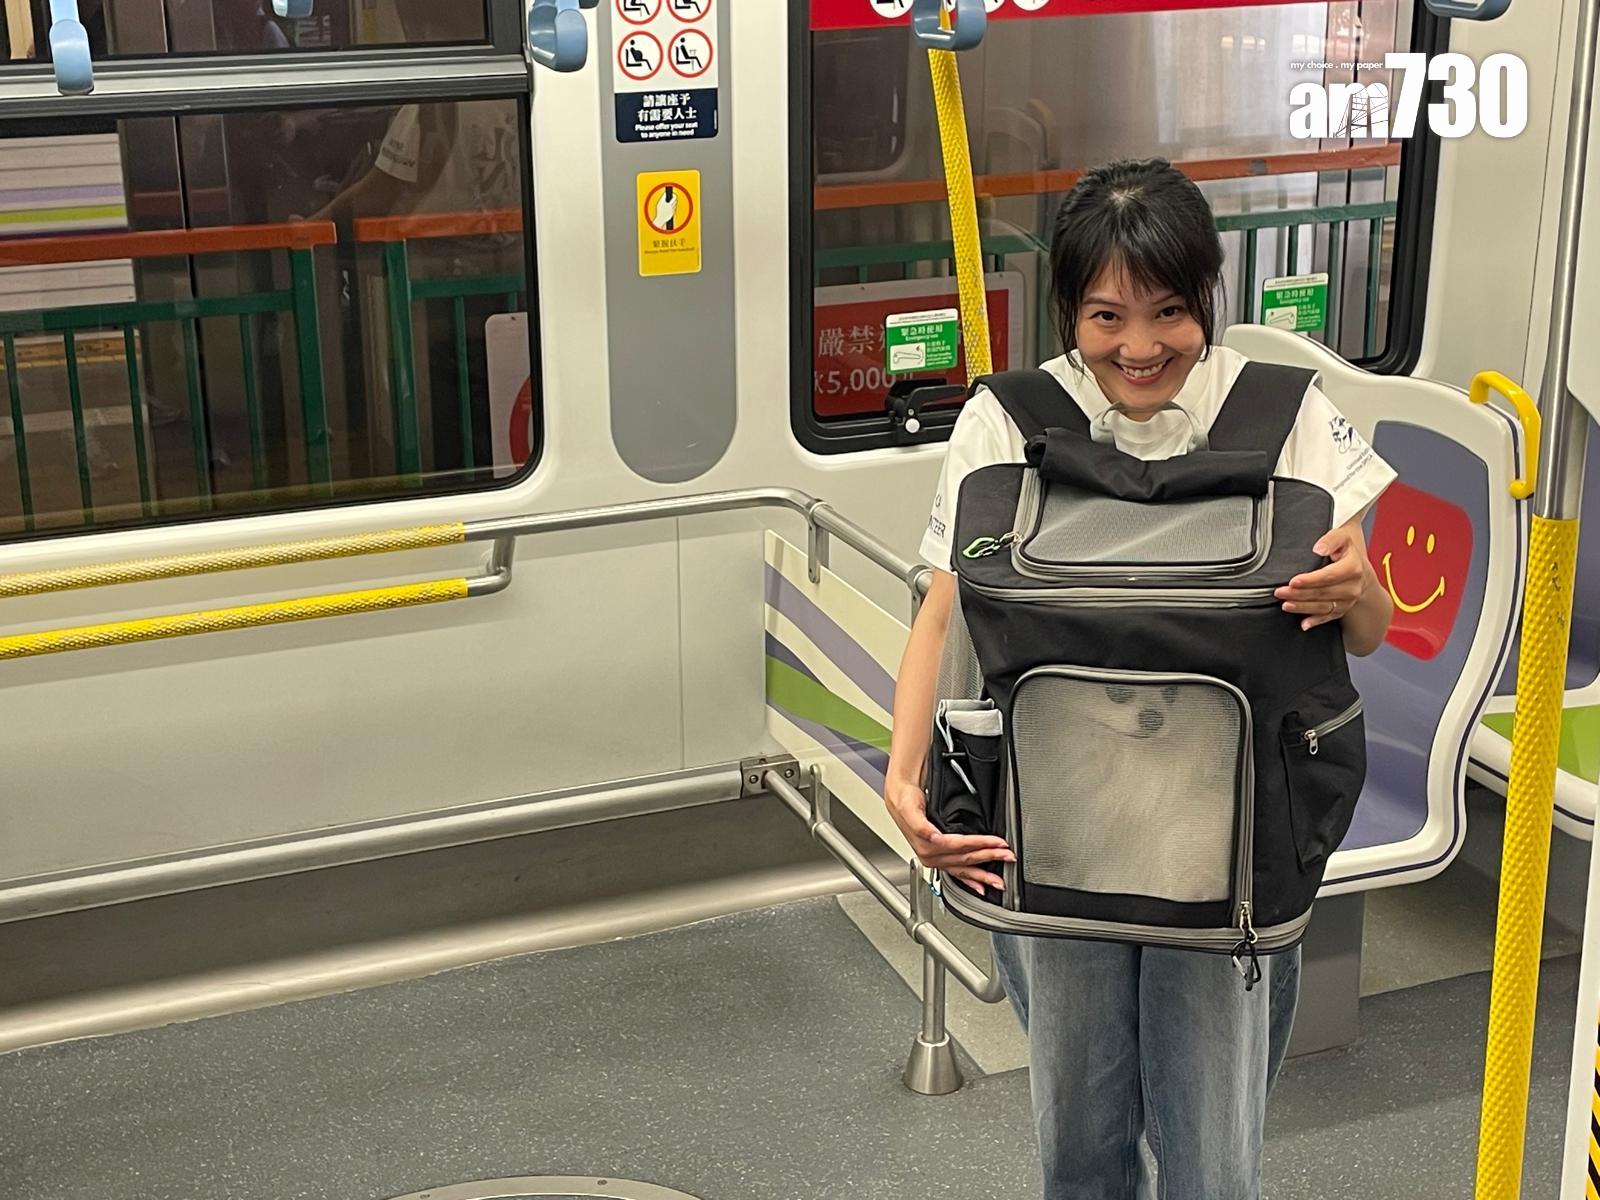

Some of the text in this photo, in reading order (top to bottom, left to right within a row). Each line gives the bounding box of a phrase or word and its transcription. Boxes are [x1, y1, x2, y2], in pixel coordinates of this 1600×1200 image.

[637, 106, 698, 122] 有需要人士
[635, 123, 655, 131] Please
[818, 324, 886, 357] 嚴禁
